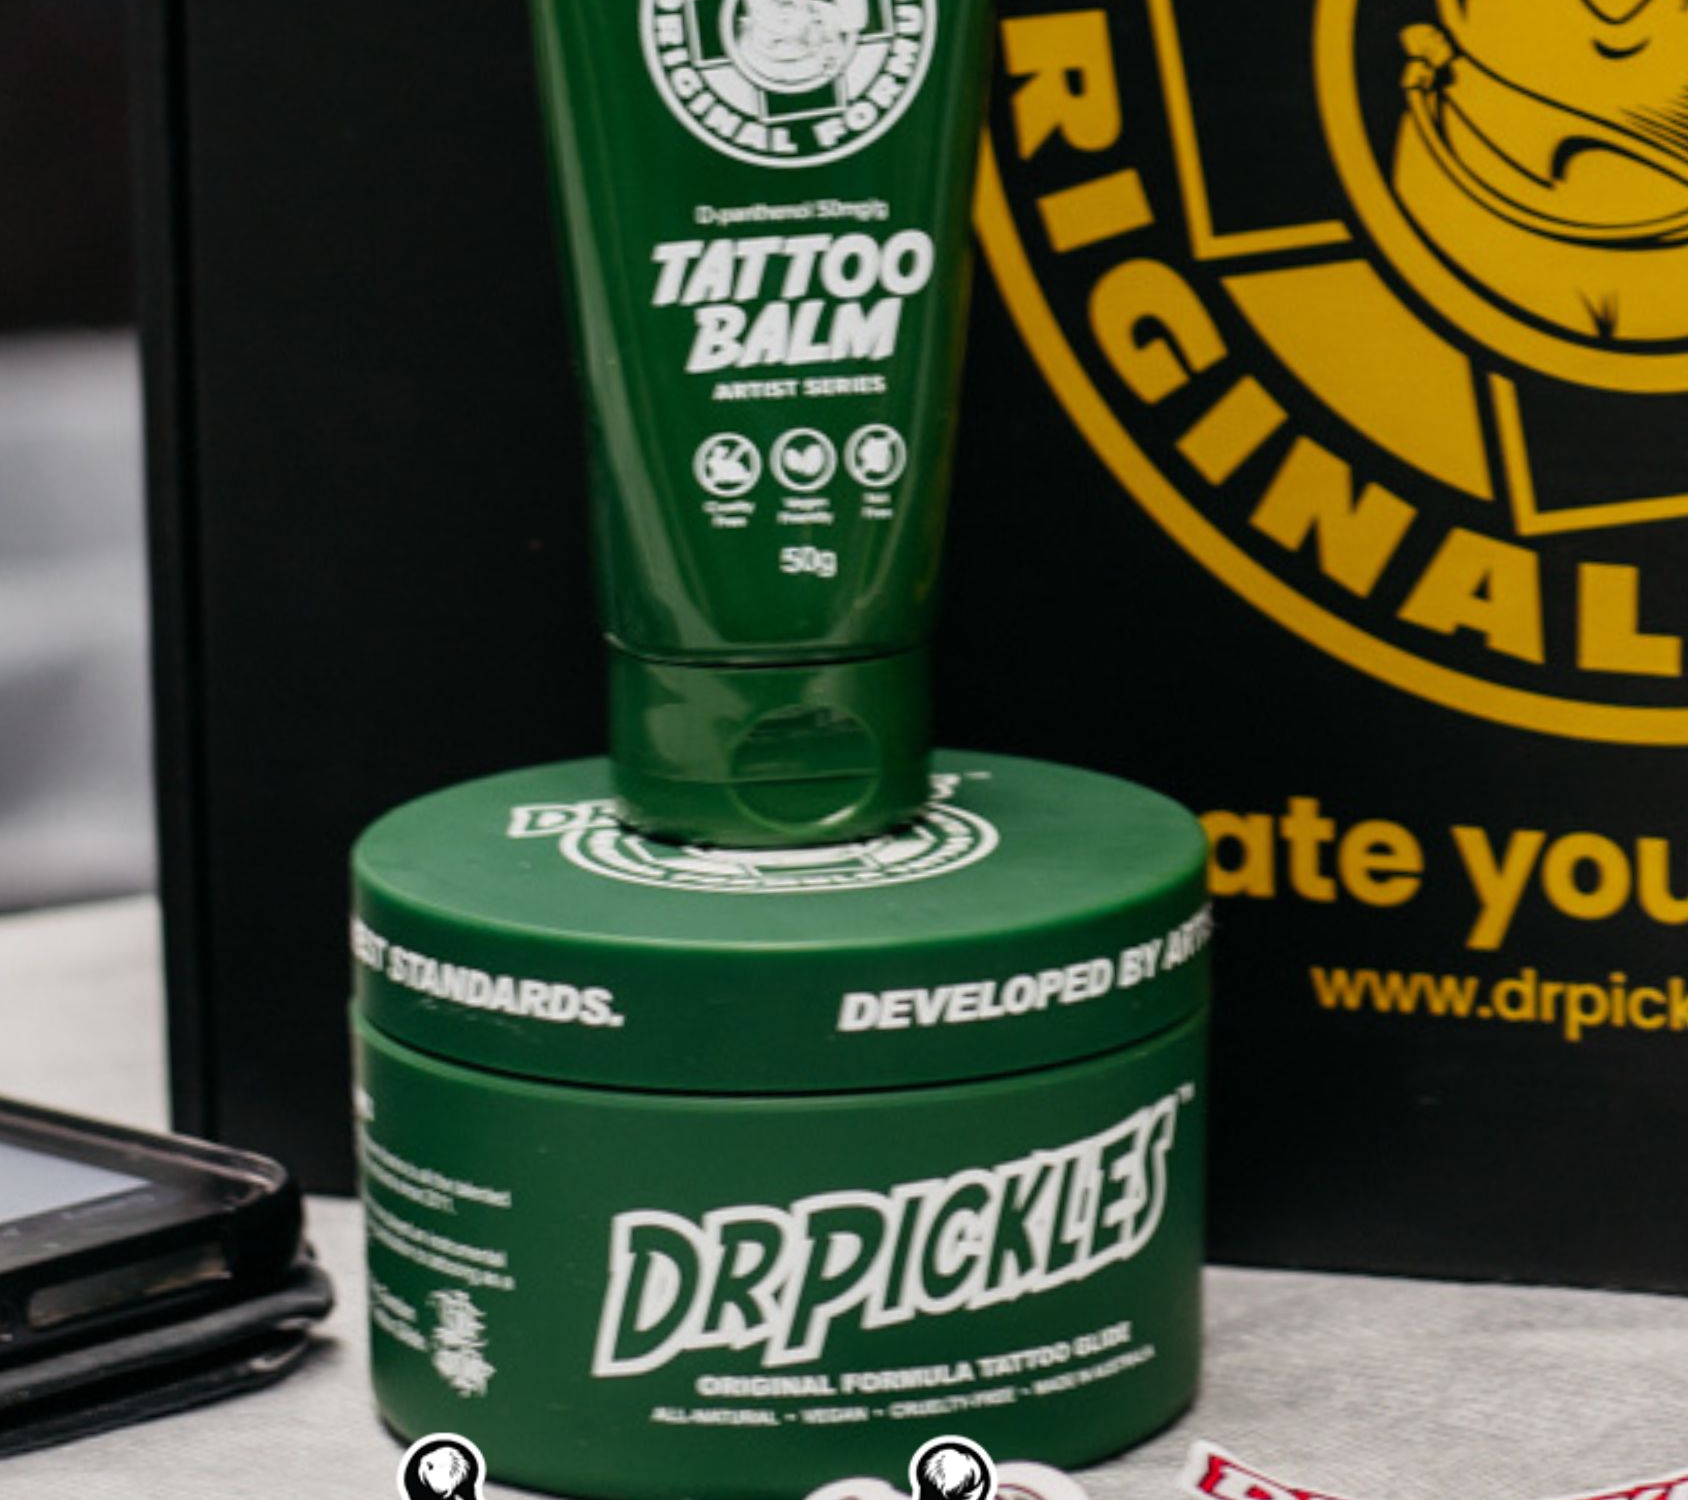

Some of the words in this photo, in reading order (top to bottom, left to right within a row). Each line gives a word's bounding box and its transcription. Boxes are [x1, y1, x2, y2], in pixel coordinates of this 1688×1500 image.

[650, 228, 935, 307] TATTOO
[683, 296, 904, 375] BALM
[711, 378, 800, 401] ARTIST
[802, 373, 888, 396] SERIES
[778, 545, 838, 579] 50g
[1203, 796, 1426, 907] ate
[386, 945, 626, 1028] STANDARDS.
[835, 957, 1114, 1033] DEVELOPED
[1117, 937, 1164, 989] BY
[694, 1373, 838, 1398] ORIGINAL
[839, 1359, 976, 1395] FORMULA
[976, 1340, 1072, 1380] TATTOO
[650, 1405, 782, 1427] ALL-NATURAL
[800, 1405, 870, 1425] VEGAN
